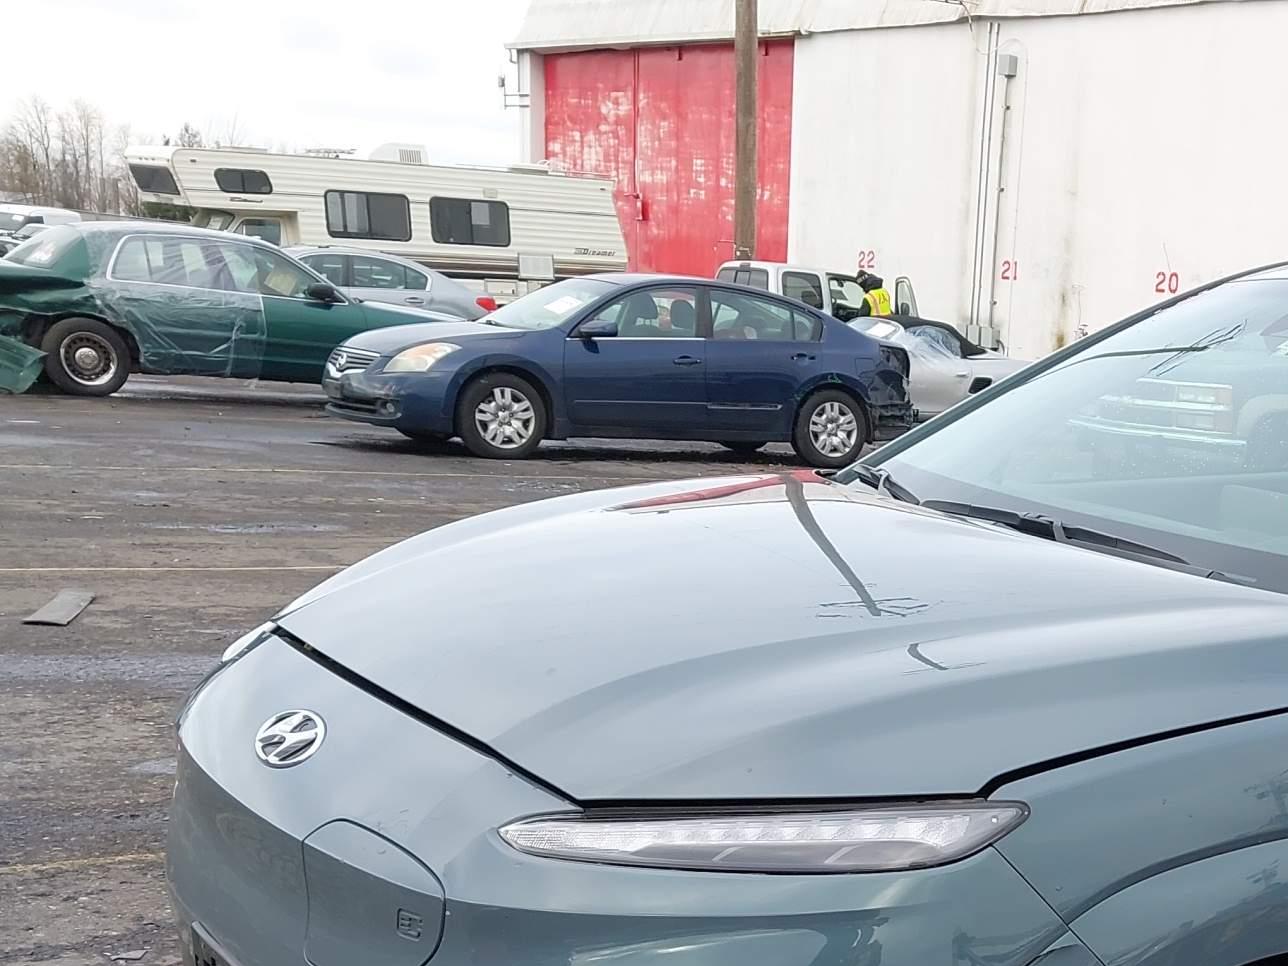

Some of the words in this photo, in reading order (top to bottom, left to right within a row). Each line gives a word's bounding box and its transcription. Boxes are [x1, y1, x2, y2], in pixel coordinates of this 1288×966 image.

[858, 250, 875, 268] 22
[1001, 260, 1018, 280] 21
[1155, 271, 1179, 294] 20
